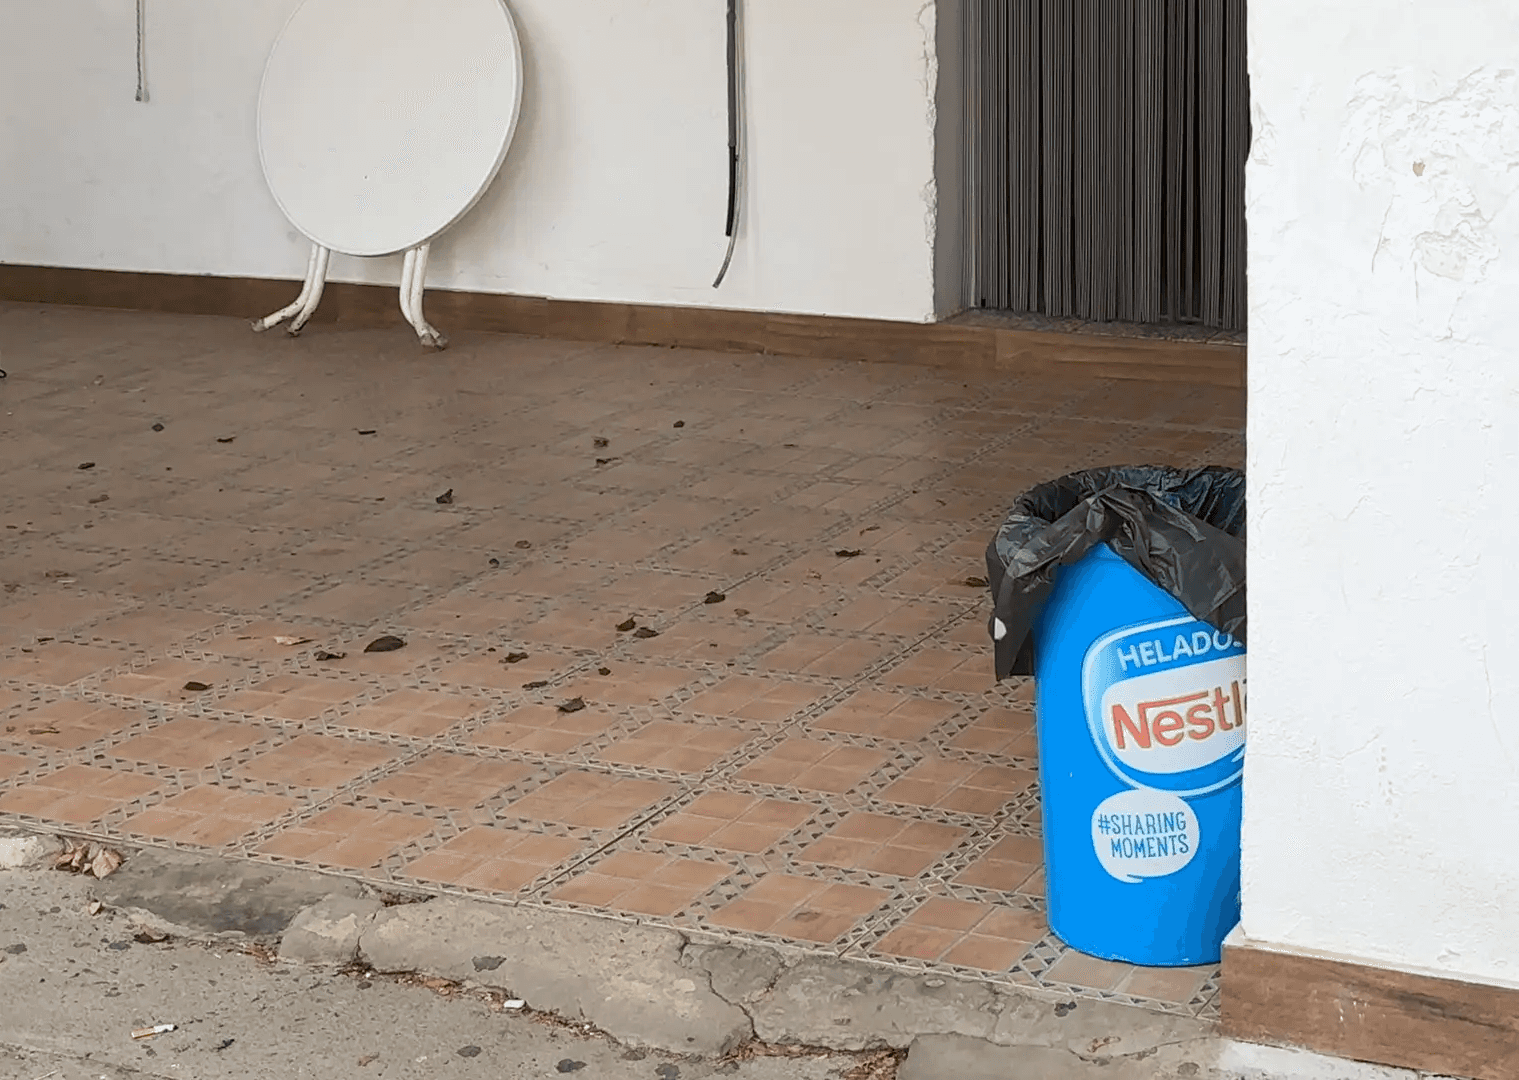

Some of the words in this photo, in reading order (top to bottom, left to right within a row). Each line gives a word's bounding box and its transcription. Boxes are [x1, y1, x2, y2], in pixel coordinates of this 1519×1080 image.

[1117, 628, 1244, 671] HELADO
[1111, 679, 1246, 749] Nestl
[1098, 811, 1186, 835] #SHARING
[1111, 833, 1189, 858] MOMENTS
